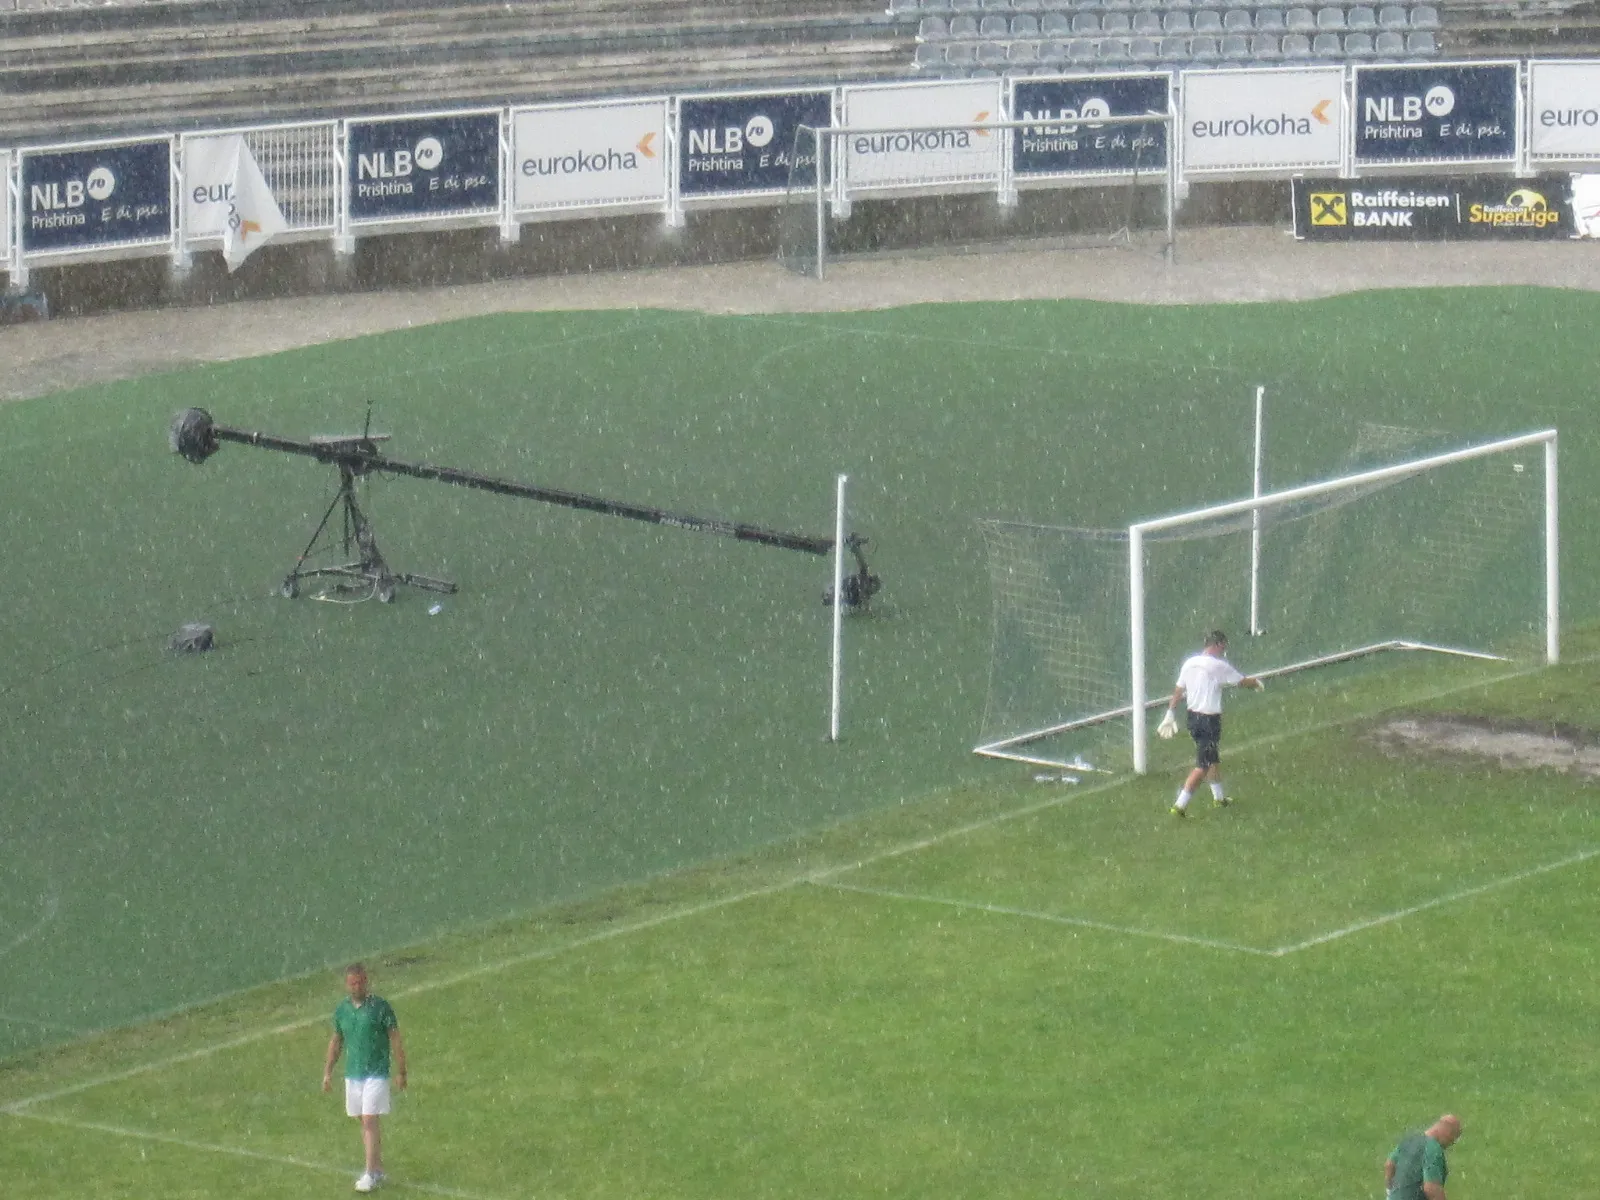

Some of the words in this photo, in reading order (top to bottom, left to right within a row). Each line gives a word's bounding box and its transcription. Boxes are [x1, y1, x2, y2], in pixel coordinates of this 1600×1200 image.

[1023, 108, 1078, 135] NLB
[1365, 96, 1423, 122] NLB
[1192, 114, 1311, 138] eurokoha
[1364, 125, 1423, 140] Prishtina
[1440, 124, 1451, 137] E
[1456, 122, 1473, 136] di
[1477, 123, 1507, 139] pse.
[688, 128, 743, 155] NLB
[855, 129, 971, 155] eurokoha
[1023, 137, 1078, 153] Prishtina
[1095, 136, 1105, 150] E
[1111, 134, 1127, 149] di
[358, 150, 413, 180] NLB
[522, 148, 637, 177] eurokoha
[688, 156, 743, 172] Prishtina
[759, 154, 770, 168] E
[774, 152, 790, 167] di
[31, 180, 86, 211] NLB
[358, 180, 413, 198] Prishtina
[428, 176, 440, 191] E
[444, 175, 460, 190] di
[1351, 190, 1450, 208] Raiffeisen
[32, 210, 86, 230] Prishtina
[101, 207, 112, 222] E
[116, 205, 132, 221] di
[1354, 211, 1413, 227] BANK
[1469, 204, 1559, 229] SuperLiga
